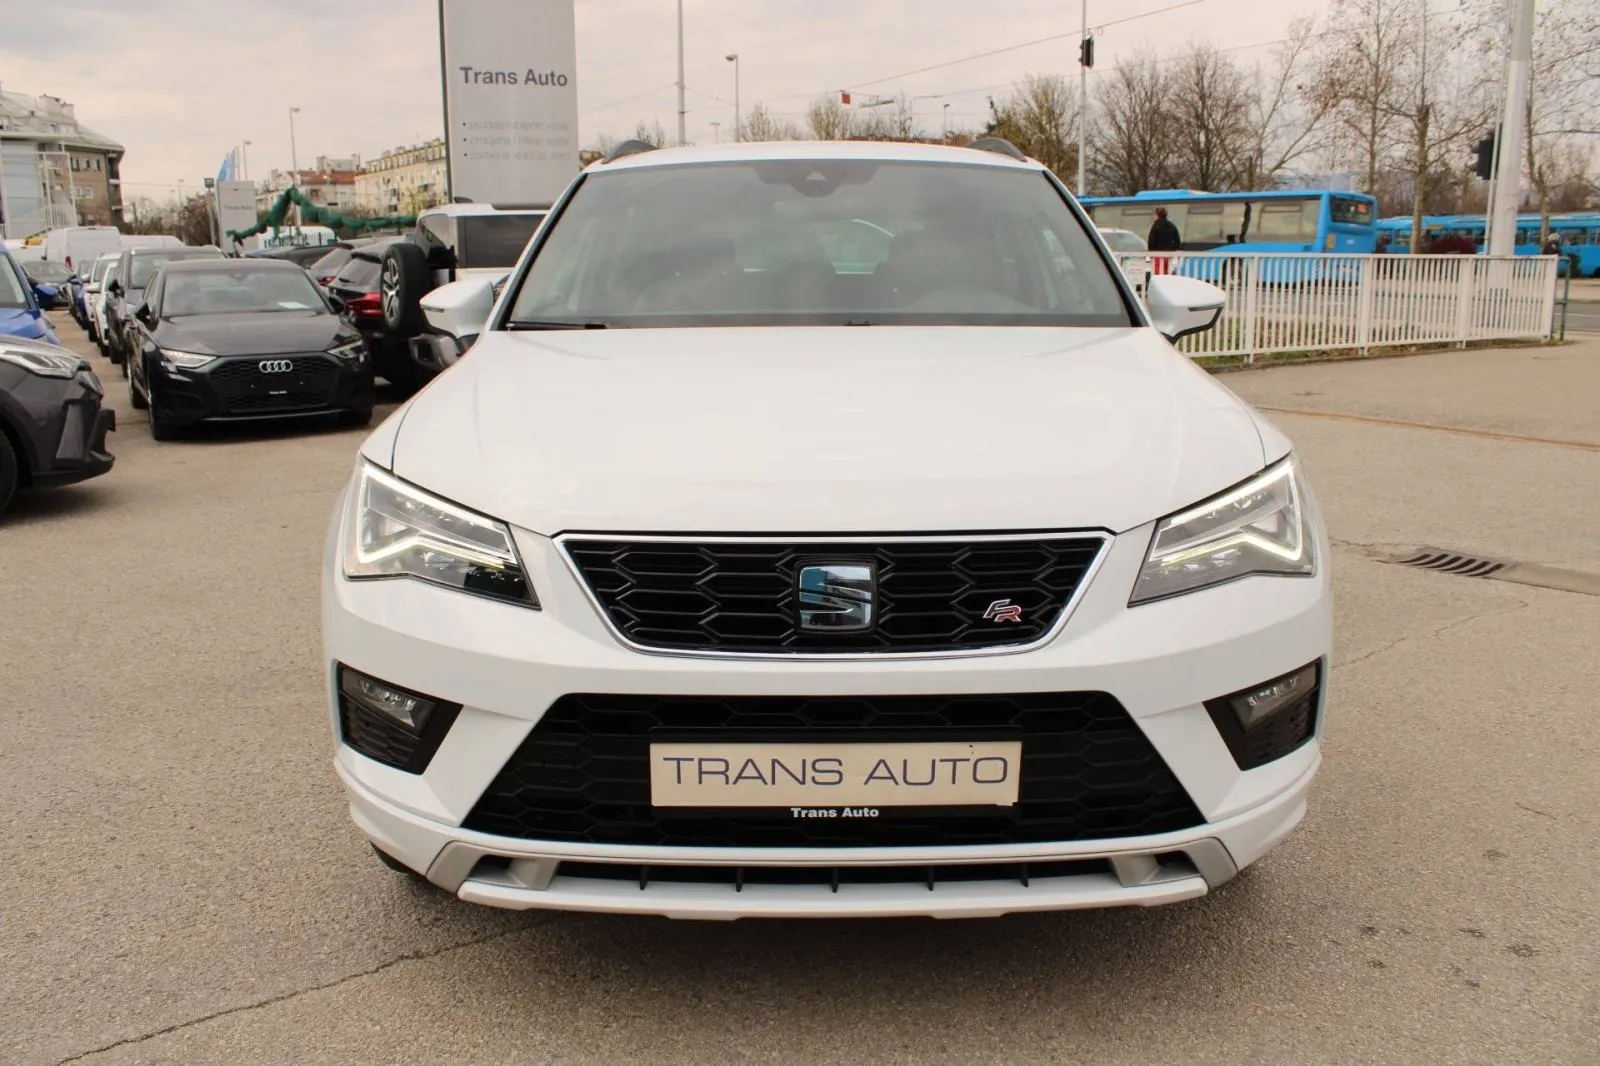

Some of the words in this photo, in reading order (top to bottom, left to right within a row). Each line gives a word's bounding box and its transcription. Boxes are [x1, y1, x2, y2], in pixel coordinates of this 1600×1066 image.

[459, 66, 518, 84] Trans
[524, 69, 568, 87] Auto
[983, 598, 1022, 622] FR
[663, 757, 843, 785] TRANS
[864, 757, 1009, 786] AUTO
[791, 807, 838, 818] Trans
[841, 807, 879, 818] Auto
